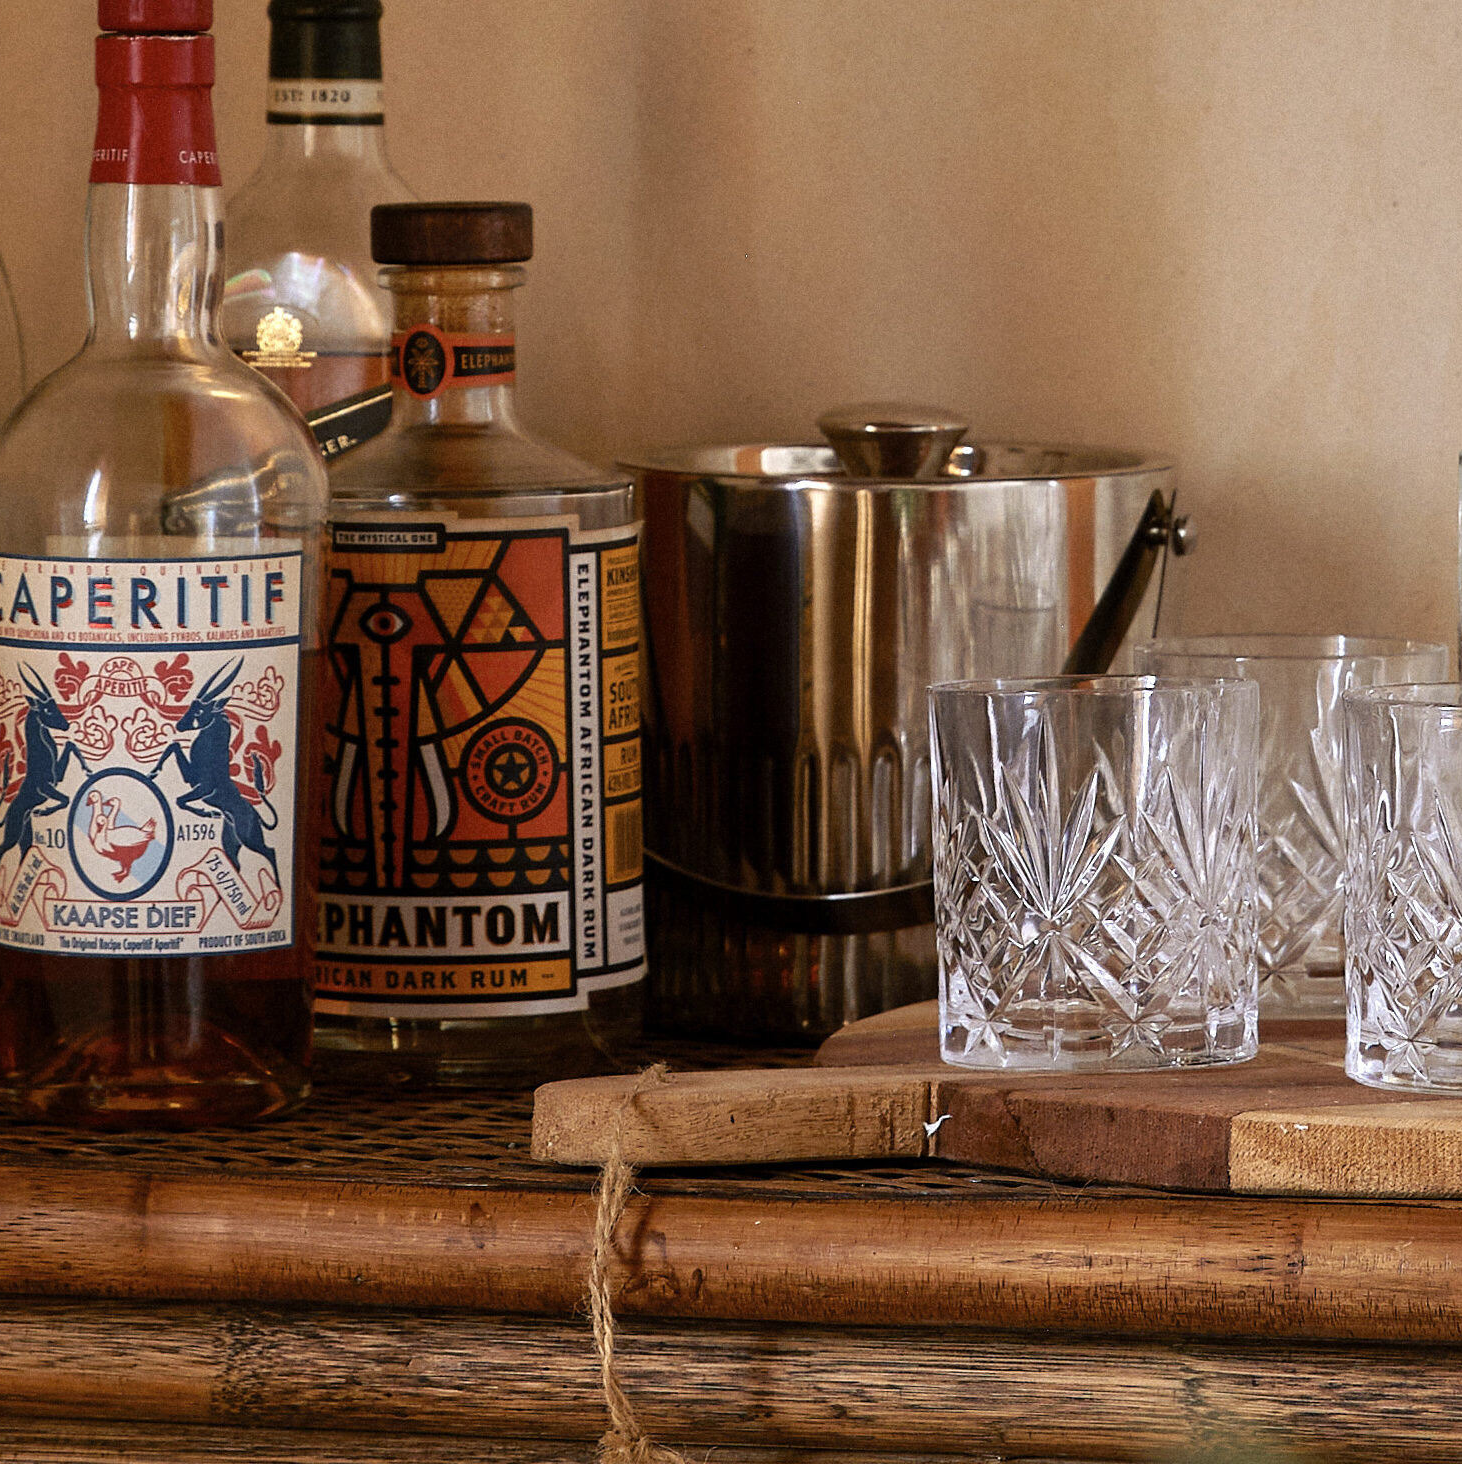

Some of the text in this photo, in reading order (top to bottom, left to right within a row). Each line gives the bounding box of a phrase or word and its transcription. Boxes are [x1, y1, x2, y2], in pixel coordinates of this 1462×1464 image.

[312, 89, 350, 102] 1820
[339, 533, 434, 543] THE MYSTICAL ONE
[104, 660, 135, 673] CAPE
[95, 678, 149, 695] APERITIF
[470, 730, 549, 769] SMALL BATCH
[577, 563, 596, 959] ELEPHANTOM AFRICAN DARK RUM
[475, 782, 546, 813] CRAFT RUM
[176, 823, 216, 842] A1596
[53, 904, 196, 928] KAAPSE DIEF
[317, 901, 560, 948] PHANTOM
[385, 970, 456, 990] DARK
[470, 968, 528, 989] RUM
